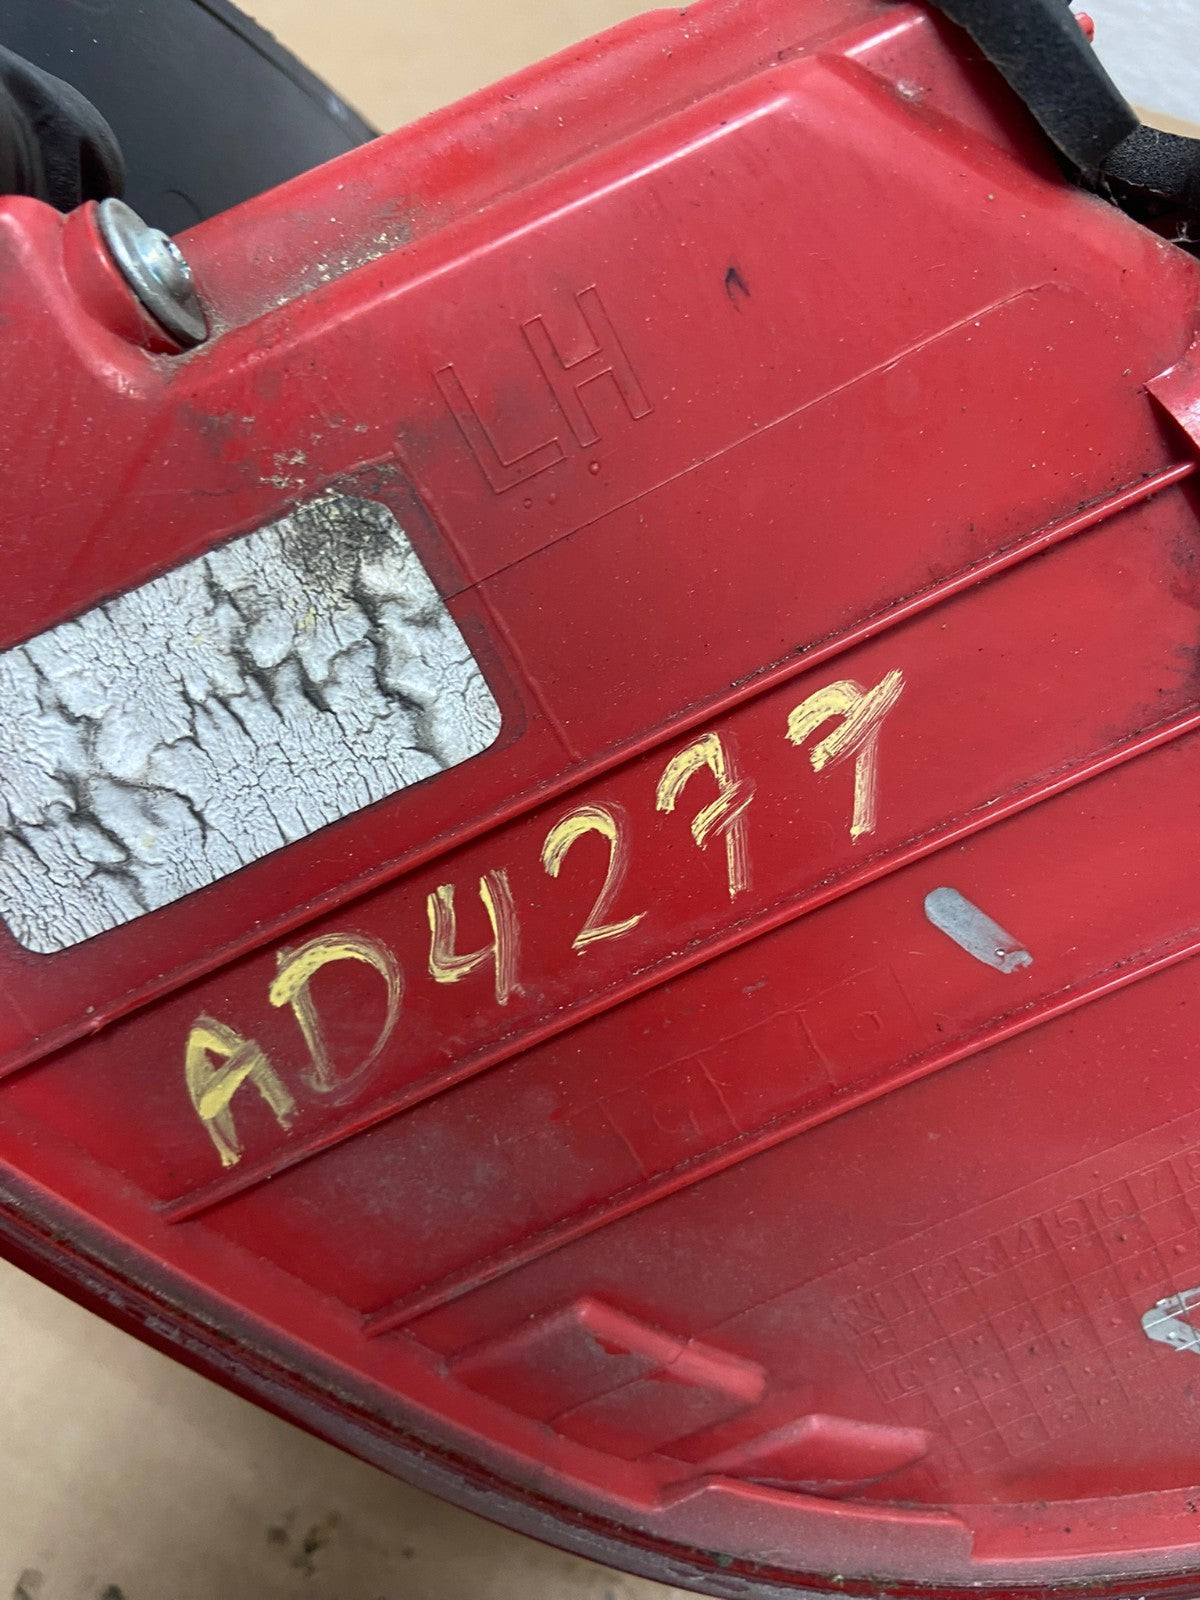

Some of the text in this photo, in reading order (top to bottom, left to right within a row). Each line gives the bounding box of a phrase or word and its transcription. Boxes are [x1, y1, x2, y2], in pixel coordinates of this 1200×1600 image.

[432, 283, 654, 495] LH
[184, 667, 904, 1167] AD4277
[1016, 1224, 1042, 1256] 4
[1053, 1204, 1085, 1240] 5
[1098, 1186, 1126, 1222] 6
